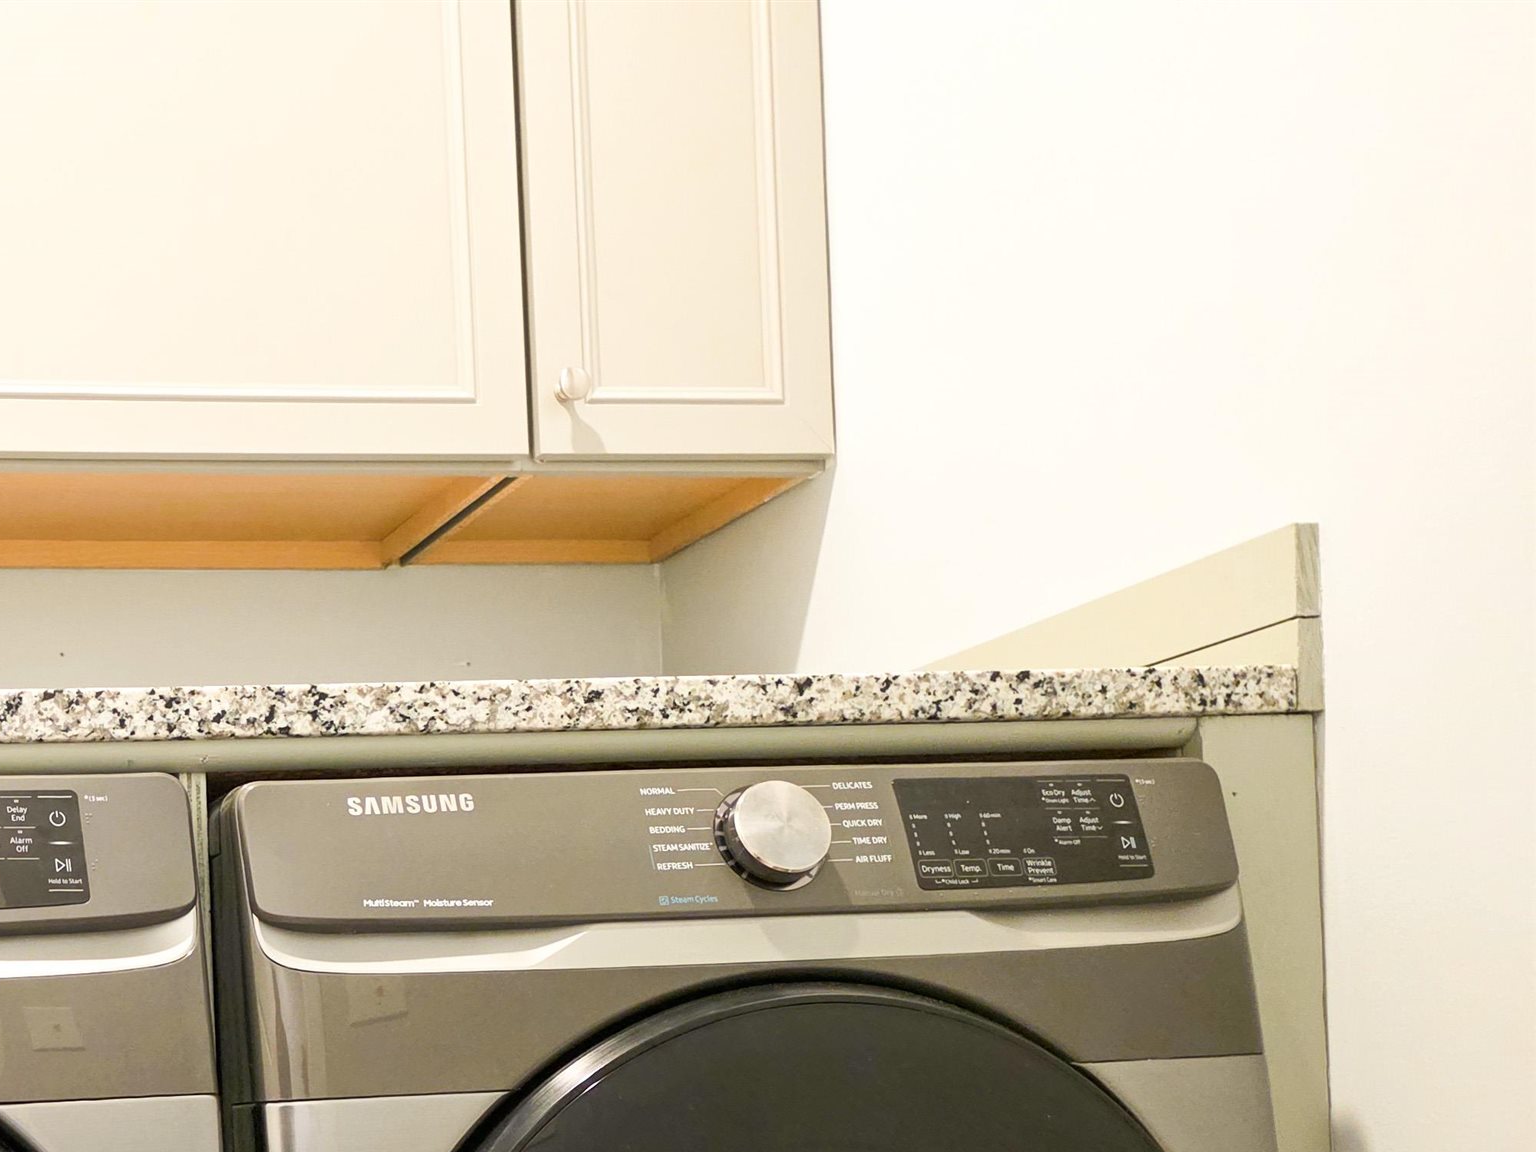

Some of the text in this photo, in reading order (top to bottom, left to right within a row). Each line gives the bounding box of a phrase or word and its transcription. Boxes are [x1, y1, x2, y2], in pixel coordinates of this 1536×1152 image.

[832, 781, 873, 790] DELICATES
[640, 787, 676, 796] NORMAL
[1053, 789, 1065, 797] Dry
[1071, 789, 1092, 797] Adjust
[347, 793, 475, 816] SAMSUNG
[834, 802, 879, 811] PERM PRESS
[7, 806, 27, 815] Delay
[645, 807, 695, 816] HEAVY DUTY
[11, 814, 25, 822] End
[1052, 817, 1072, 825] Damp
[1079, 817, 1099, 825] Adjust
[842, 818, 883, 828] QUICK DRY
[649, 825, 686, 834] BEDDING
[852, 836, 888, 845] TIME DRY
[16, 845, 29, 853] Off
[653, 843, 679, 852] STEAM
[855, 854, 893, 863] AIR FLUFF
[1026, 859, 1053, 867] Wrinkle
[657, 861, 694, 871] REFRESH
[921, 864, 952, 874] Dryness
[960, 864, 982, 873] Temp.
[996, 863, 1015, 872] Time
[1027, 867, 1055, 875] Prevent
[423, 899, 462, 908] Moisture
[462, 898, 493, 907] Sensor
[670, 894, 719, 904] Steam Cycles
